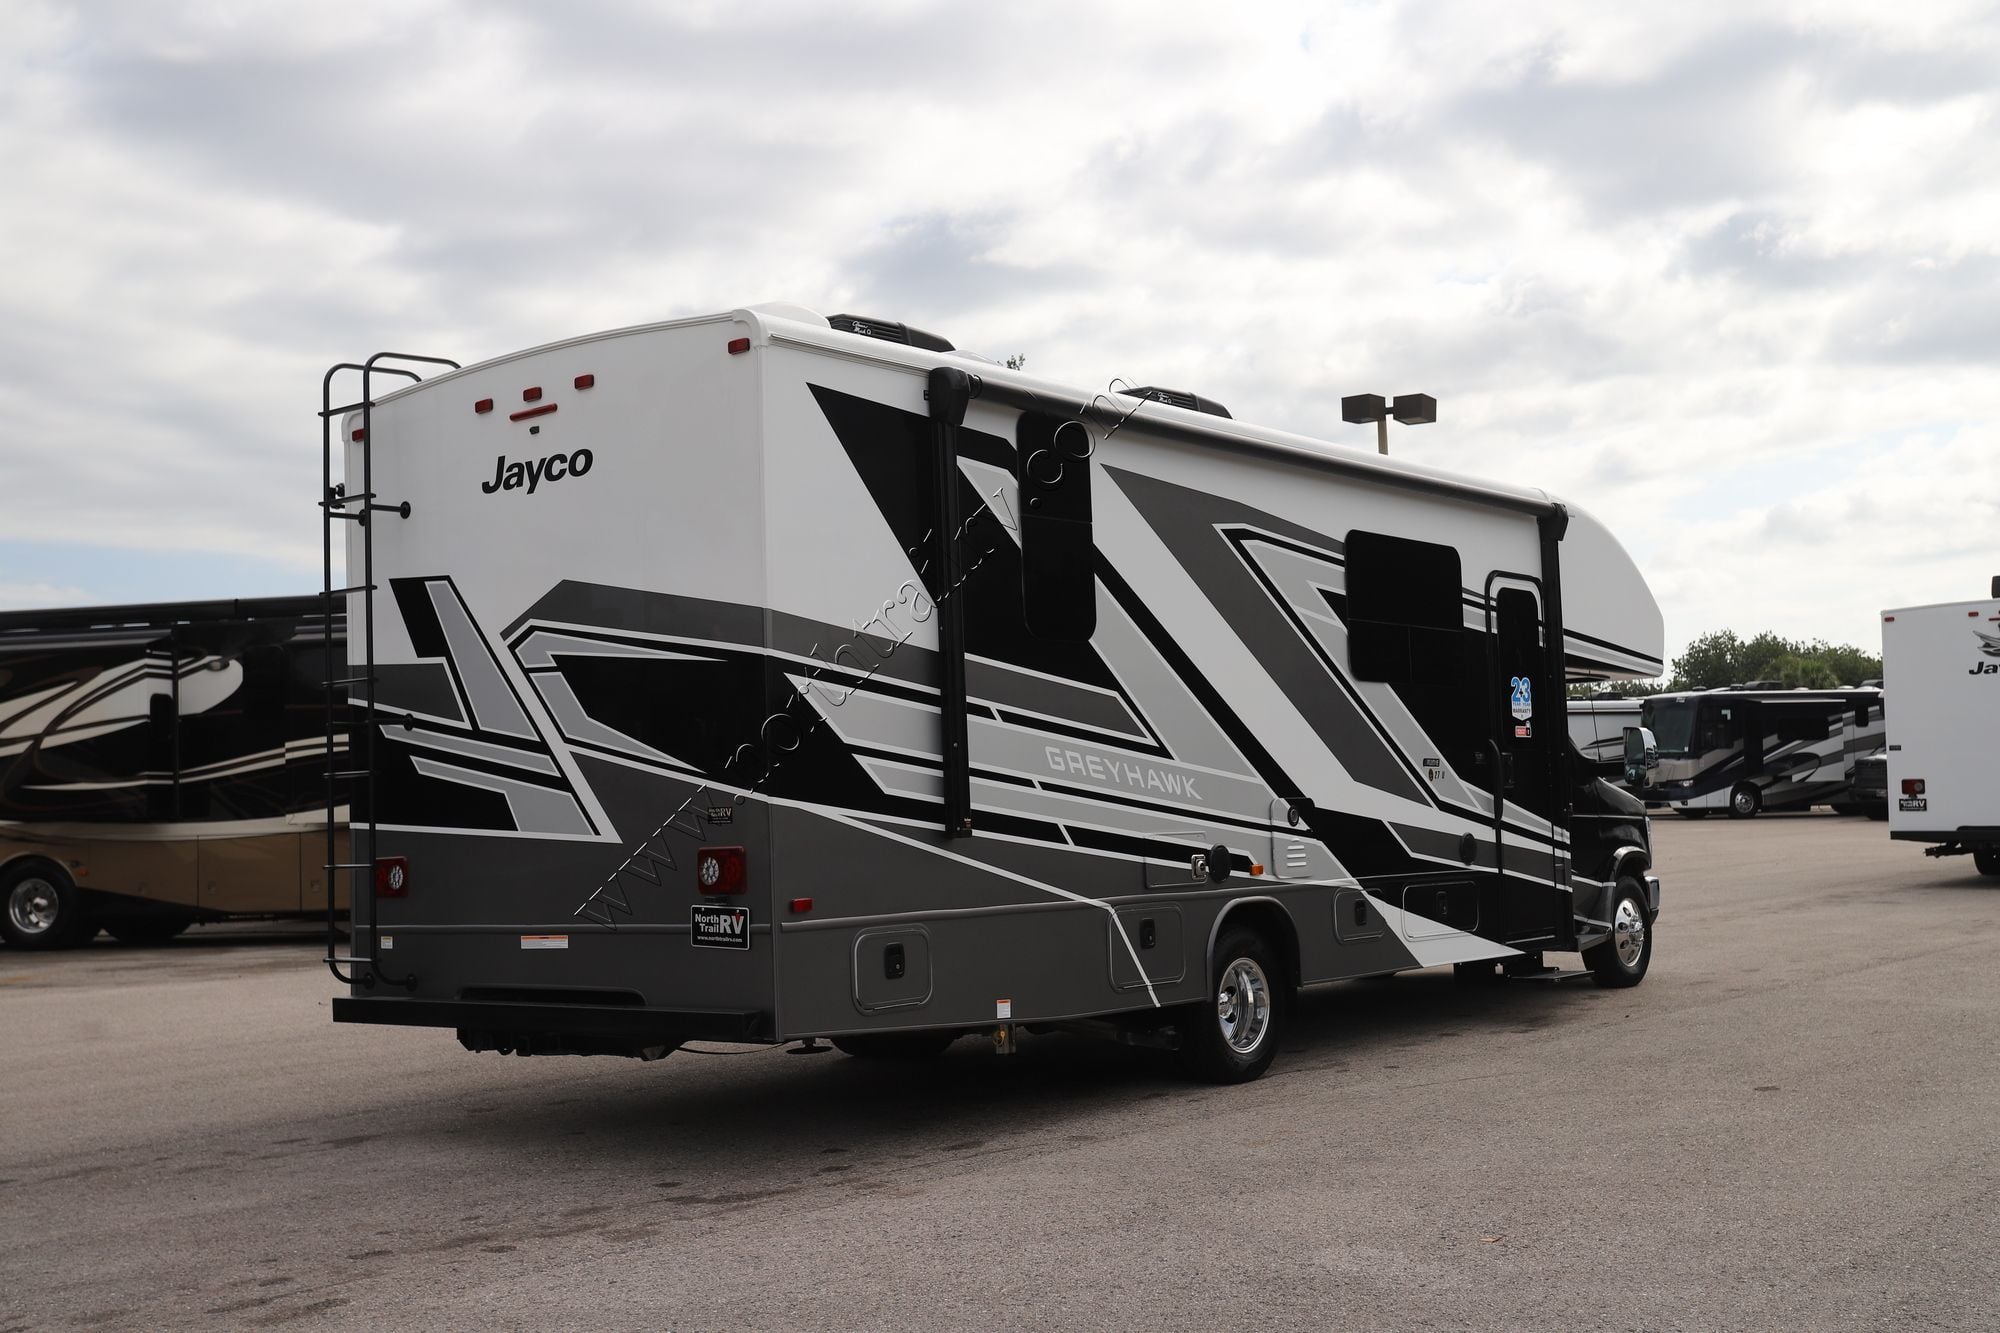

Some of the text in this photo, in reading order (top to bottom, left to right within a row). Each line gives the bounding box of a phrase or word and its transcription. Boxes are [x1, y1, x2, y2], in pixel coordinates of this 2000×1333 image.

[481, 448, 594, 495] Jayco
[1968, 661, 2000, 675] Ja
[1045, 746, 1204, 800] GREYHAWK
[695, 914, 719, 924] North
[720, 915, 744, 935] RV
[699, 923, 719, 933] Trail
